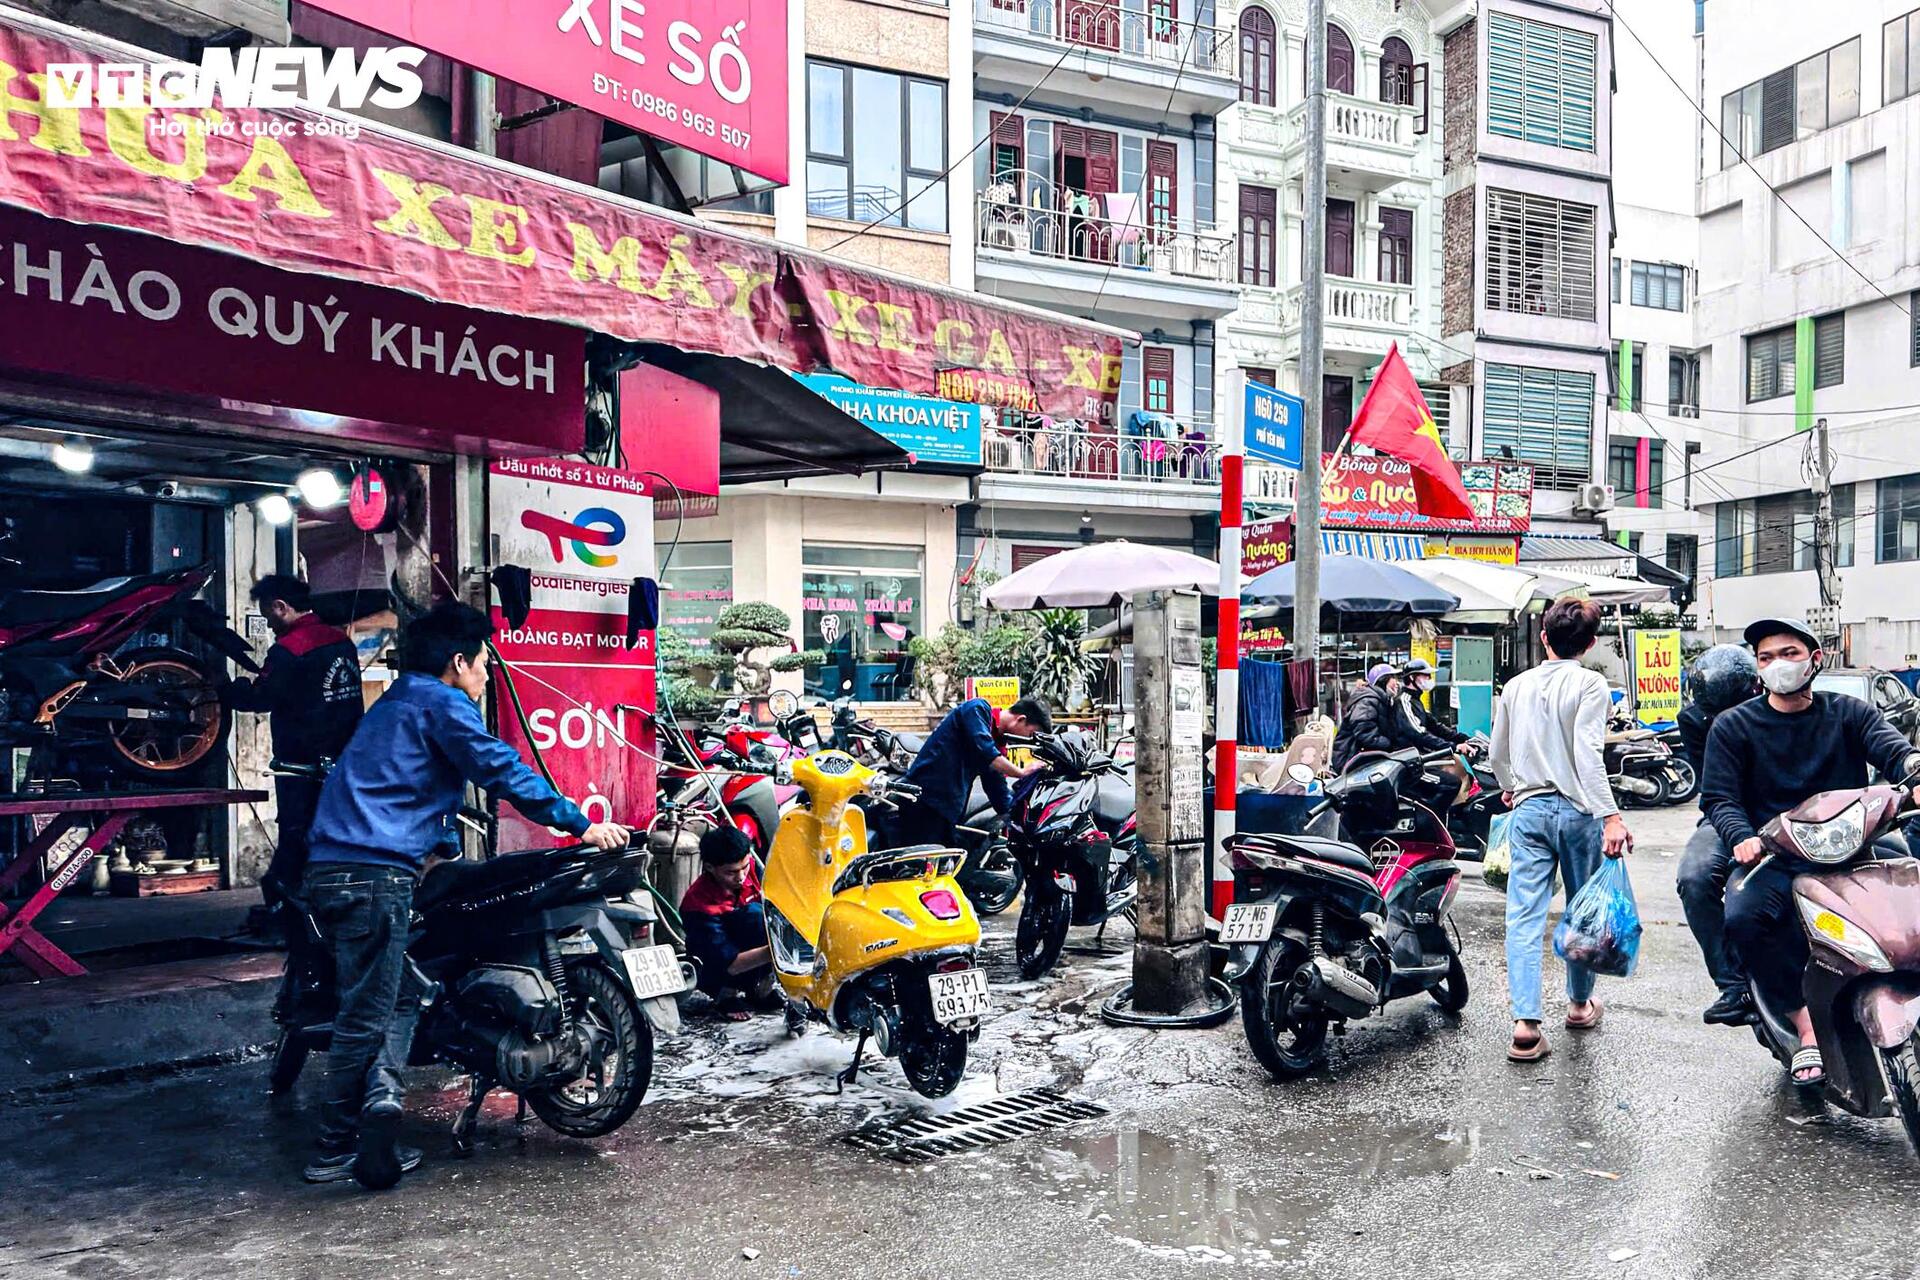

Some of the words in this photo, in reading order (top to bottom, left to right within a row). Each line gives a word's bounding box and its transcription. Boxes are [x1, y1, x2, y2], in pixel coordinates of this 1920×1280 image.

[557, 0, 646, 66] XE
[667, 20, 751, 104] SỐ
[592, 72, 627, 101] ĐT:
[631, 88, 678, 122] 0986
[682, 104, 716, 137] 963
[721, 124, 751, 150] 507
[371, 166, 537, 268] XE
[567, 222, 774, 318] MÁY
[825, 289, 916, 354] XE
[934, 319, 1022, 377] GA
[0, 242, 181, 321] HÀO
[208, 286, 350, 354] QUÝ
[371, 316, 555, 394] KHÁCH
[877, 403, 929, 427] KHOA
[930, 405, 971, 433] VIỆT
[1255, 394, 1272, 421] NGÕ
[1273, 402, 1288, 426] 259
[531, 462, 563, 480] nhớt
[566, 467, 582, 483] số
[585, 472, 593, 484] 1
[596, 472, 610, 486] từ
[613, 476, 645, 493] Pháp
[1370, 478, 1417, 508] Nướ
[1246, 538, 1287, 563] Nướng
[531, 575, 629, 597] otalEnergies
[500, 626, 558, 646] HOÀNG
[562, 632, 593, 650] ĐẠT
[1644, 641, 1671, 668] LẨU
[1638, 672, 1679, 694] NƯỚNG
[529, 702, 626, 749] SƠN
[1230, 906, 1268, 923] 37-N6
[1226, 923, 1264, 939] 5713
[635, 969, 681, 994] 003.35
[938, 973, 979, 997] 29-P1
[937, 992, 988, 1018] 993.75
